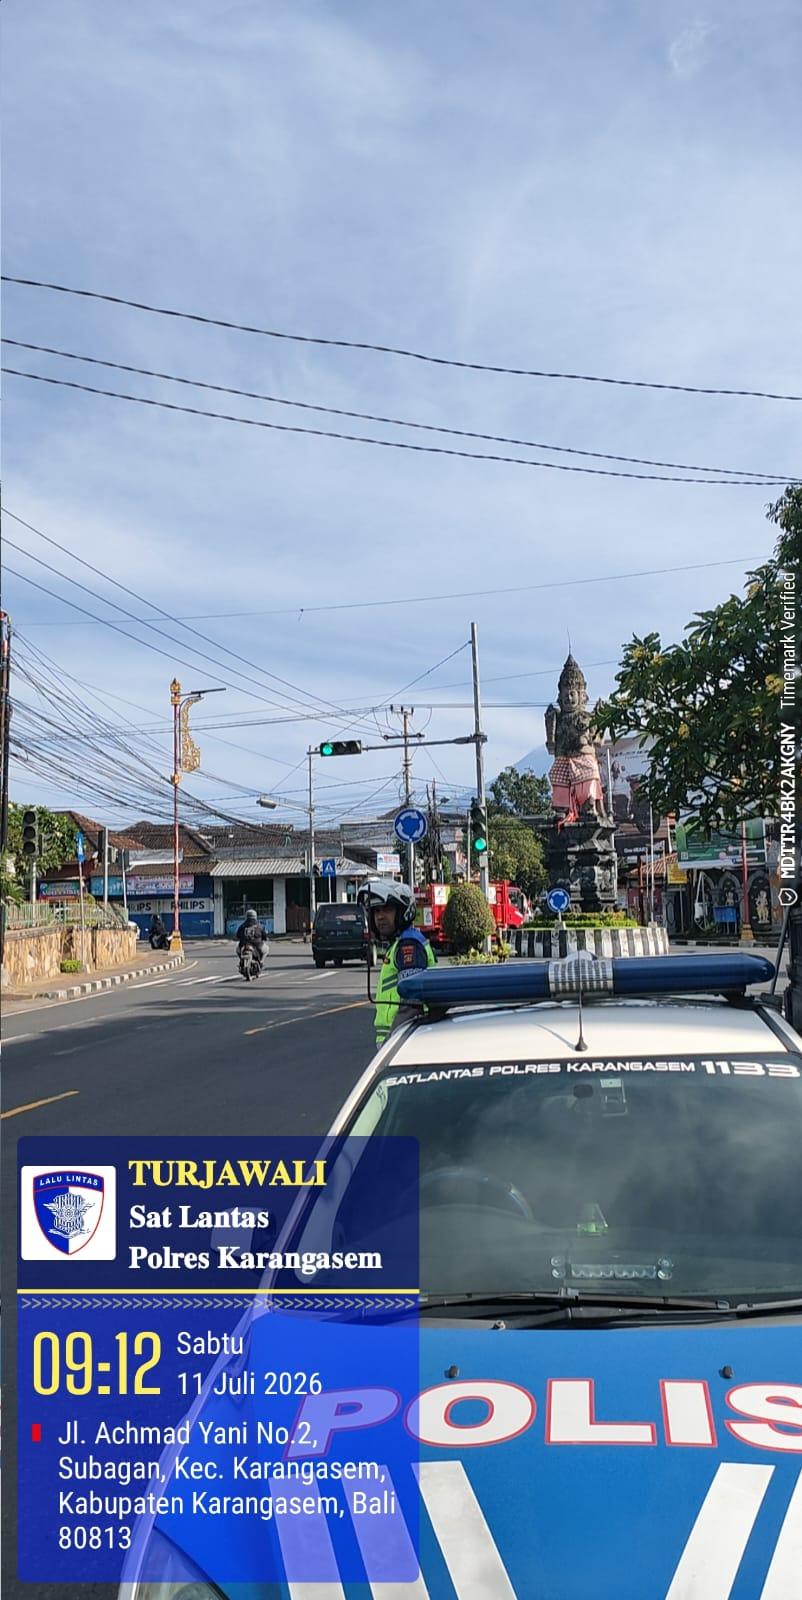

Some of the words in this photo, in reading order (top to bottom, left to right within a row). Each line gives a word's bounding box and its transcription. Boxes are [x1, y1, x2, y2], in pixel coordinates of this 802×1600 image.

[384, 1067, 484, 1086] SATLANTAS
[489, 1062, 561, 1076] POLRES
[567, 1061, 695, 1073] KARANGASEM
[701, 1060, 801, 1078] 1133
